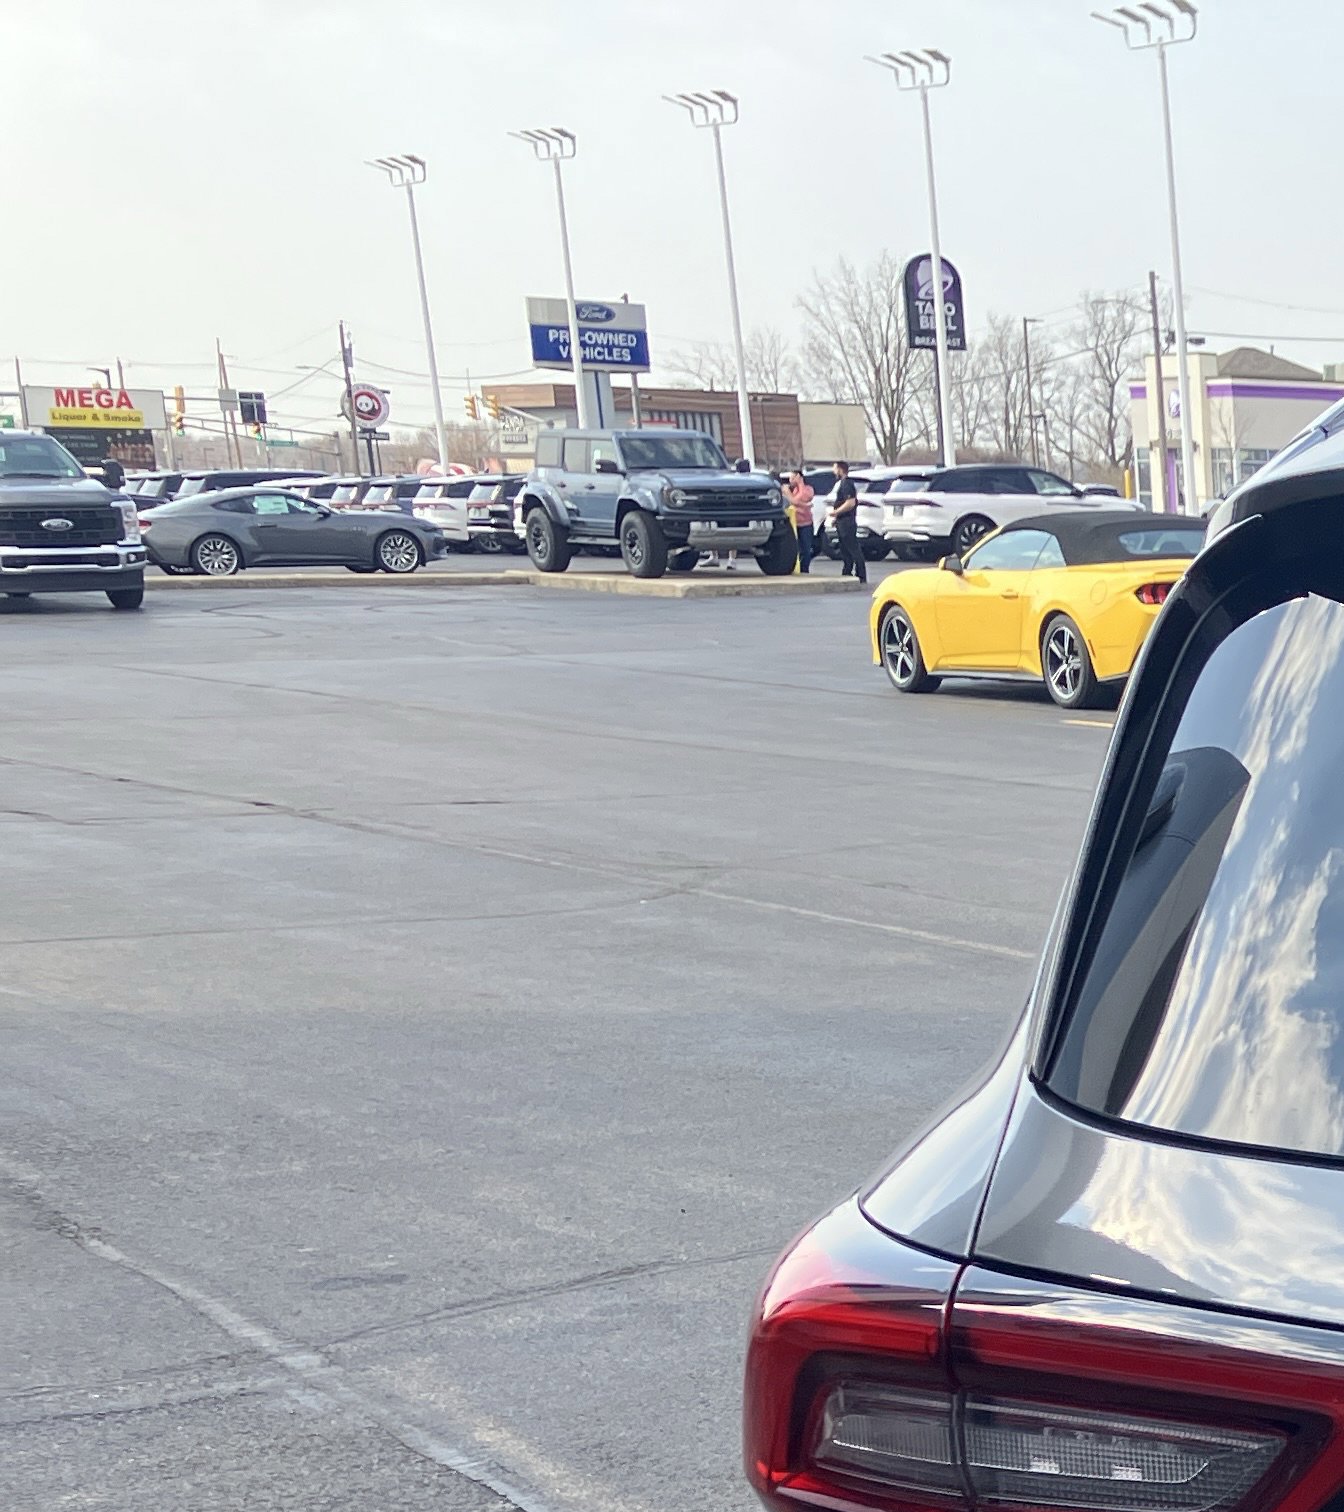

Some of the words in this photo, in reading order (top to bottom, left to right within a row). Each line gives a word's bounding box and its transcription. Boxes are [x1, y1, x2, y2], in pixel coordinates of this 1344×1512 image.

[579, 304, 607, 319] Ford
[915, 301, 956, 316] TAO
[548, 329, 637, 348] PR-OWNED
[558, 345, 631, 362] VHICLES
[54, 388, 134, 409] MEGA
